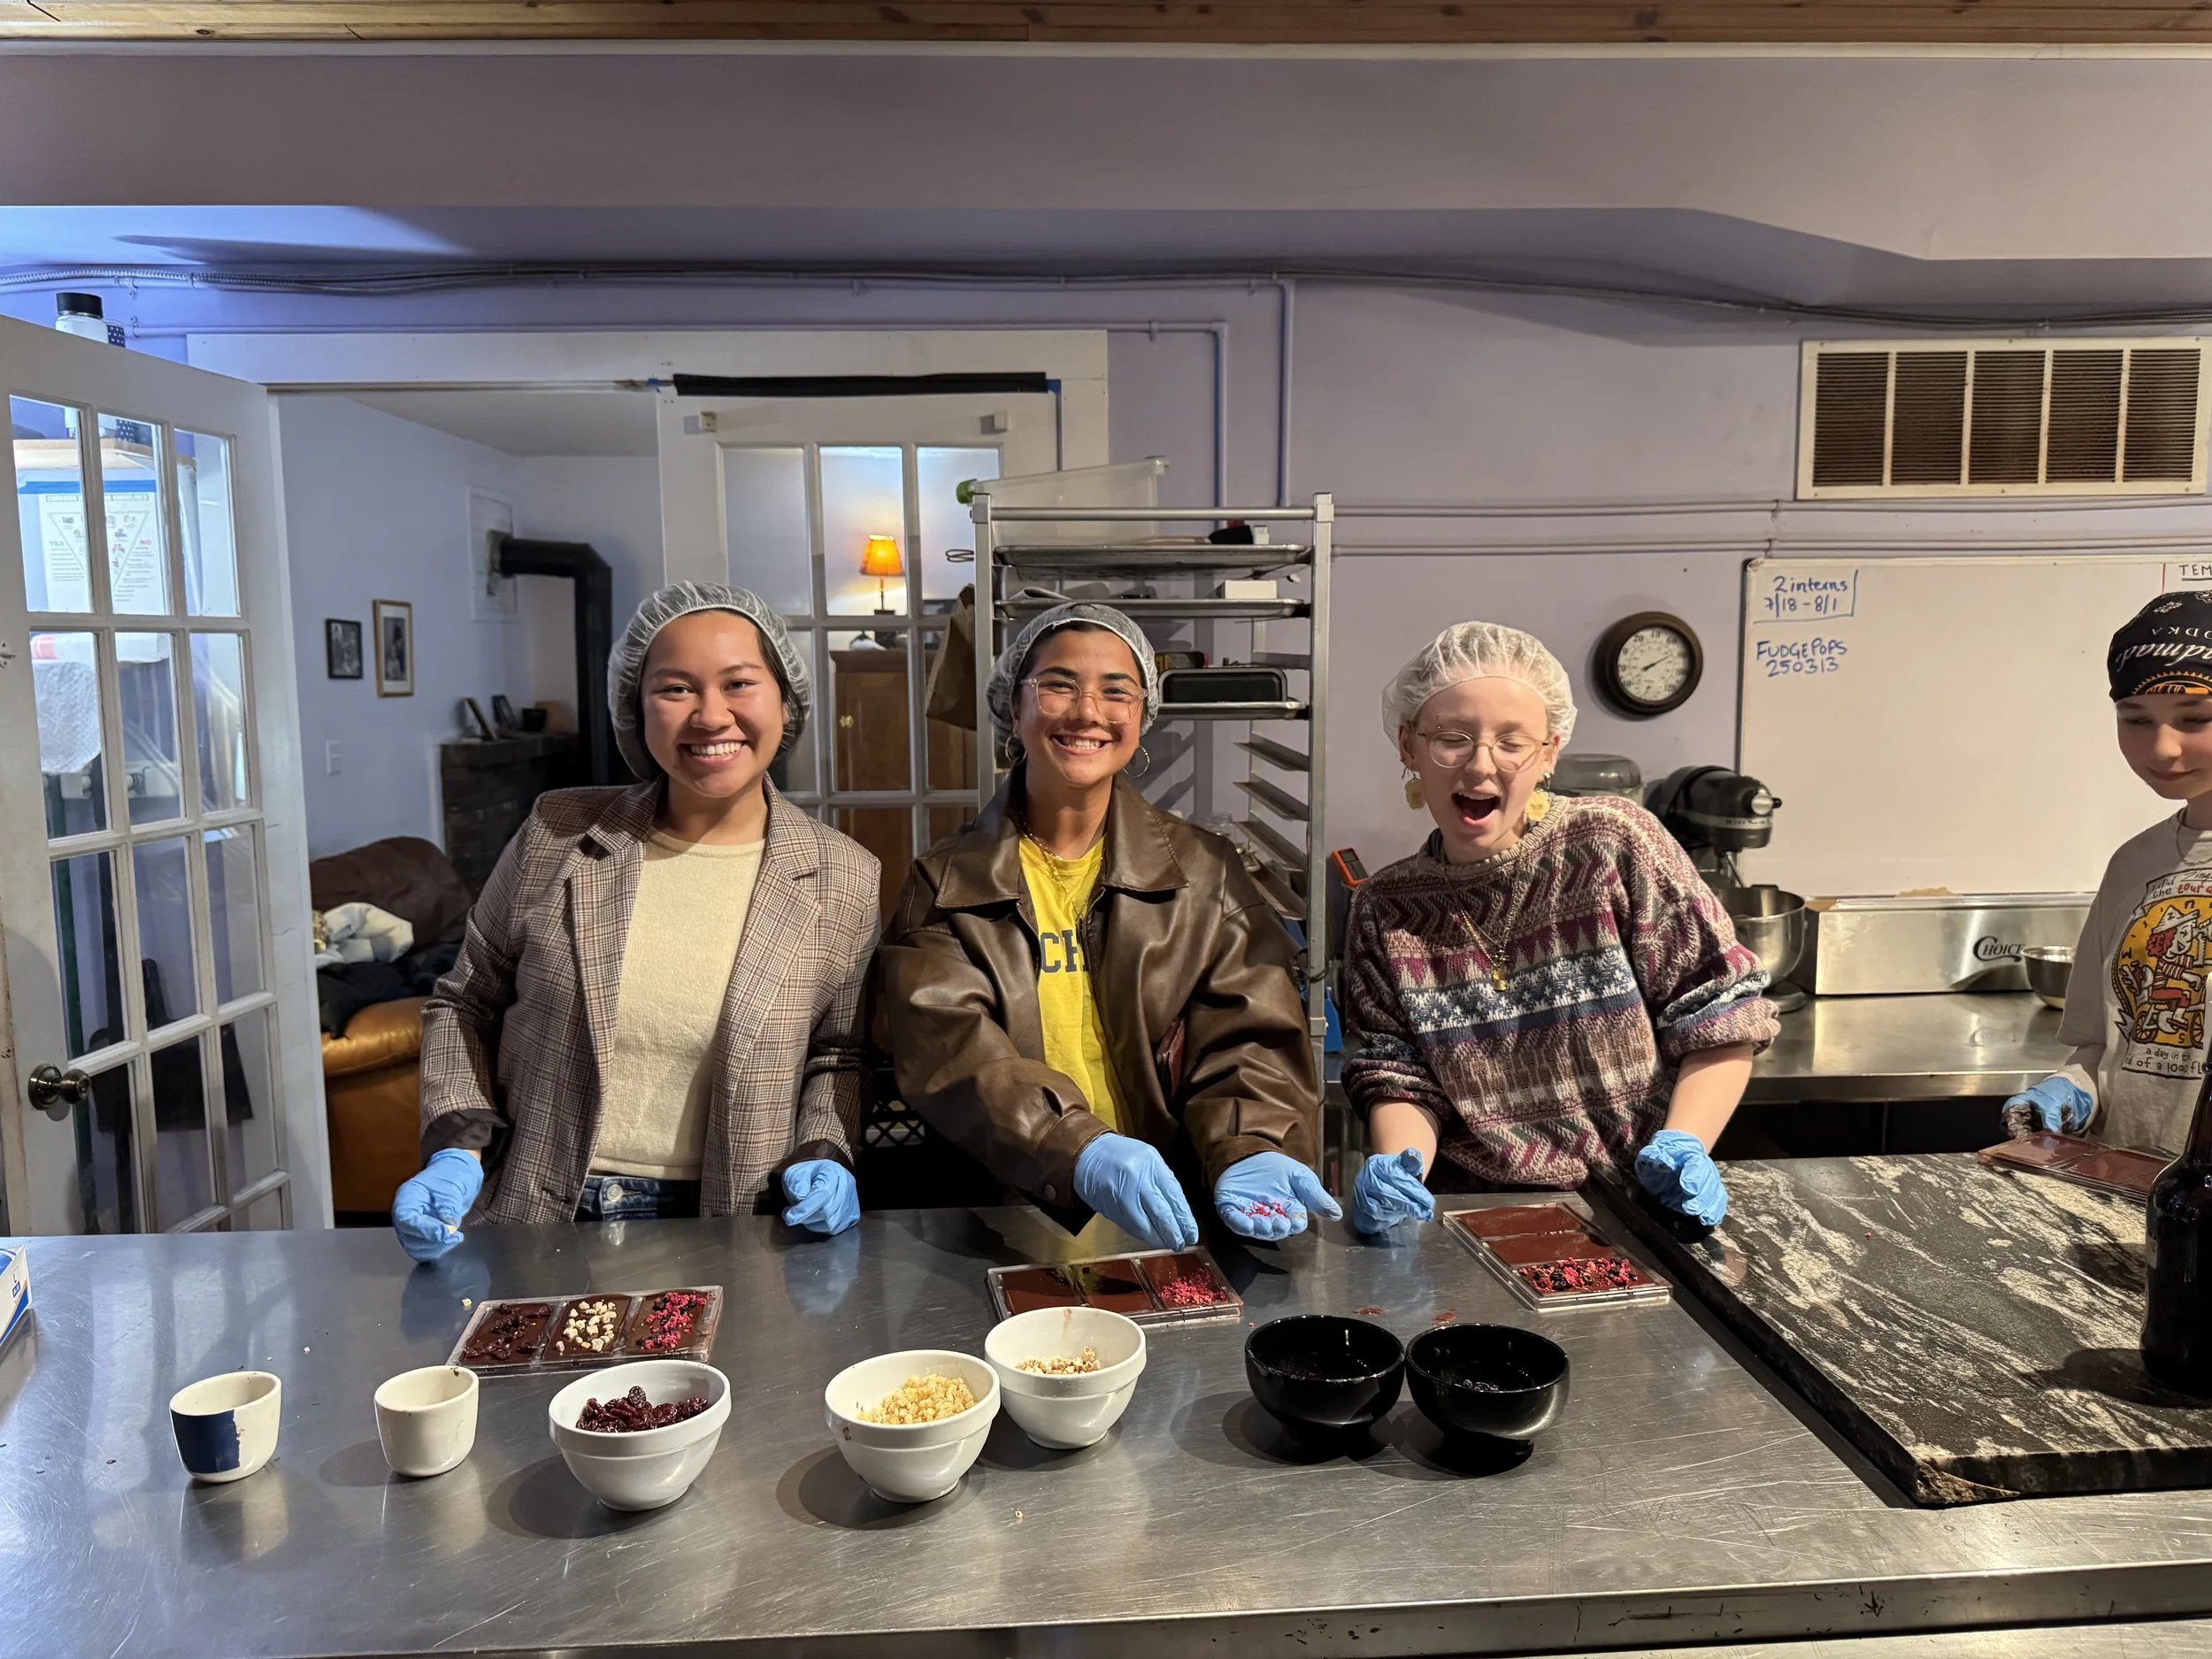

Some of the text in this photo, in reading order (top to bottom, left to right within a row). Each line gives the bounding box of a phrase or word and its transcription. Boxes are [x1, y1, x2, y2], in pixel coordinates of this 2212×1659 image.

[1773, 576, 1787, 593] 2
[1764, 593, 1797, 618] 7/18
[1815, 595, 1837, 614] 8/1
[1756, 641, 1808, 660] FUDGE
[1766, 657, 1839, 678] 250313
[2177, 883, 2204, 894] tour
[2136, 1056, 2153, 1067] of
[2154, 1048, 2169, 1060] day
